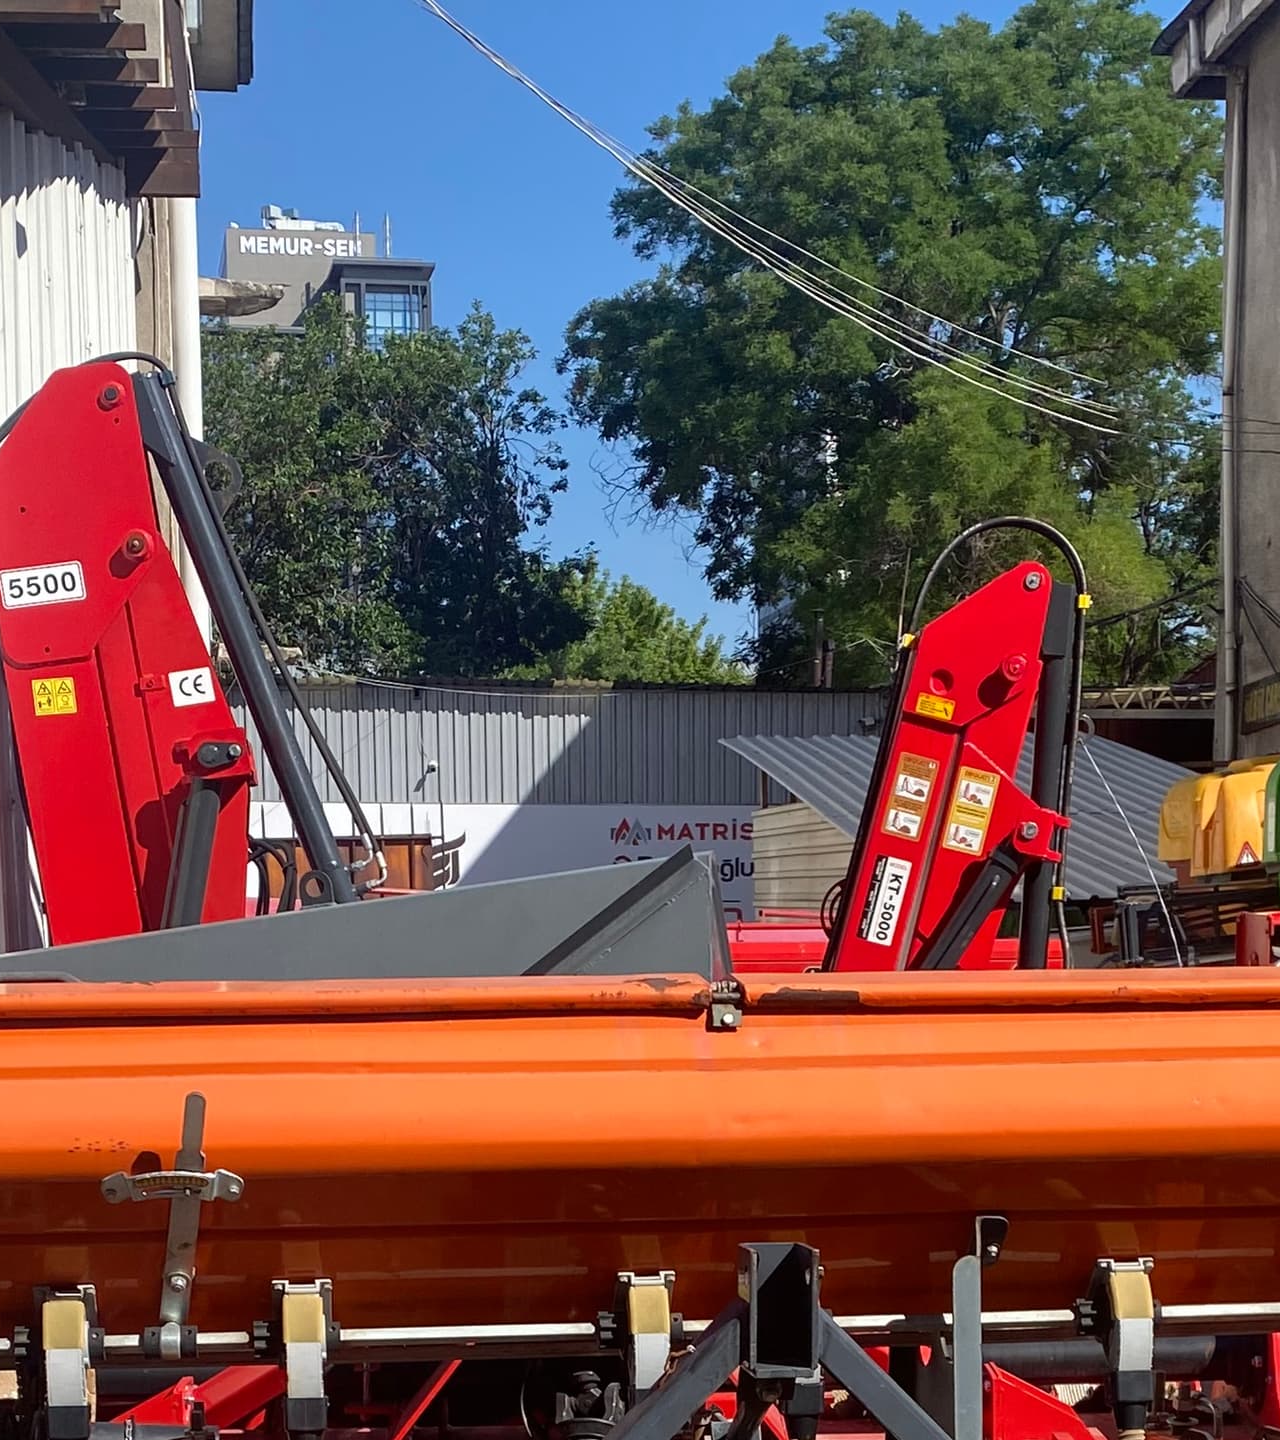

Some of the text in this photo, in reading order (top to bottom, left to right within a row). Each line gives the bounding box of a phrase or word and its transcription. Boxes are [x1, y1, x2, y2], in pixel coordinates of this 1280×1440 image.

[240, 235, 362, 257] MEMUR-SEN
[8, 571, 77, 599] 5500
[178, 674, 206, 696] CE
[875, 872, 904, 941] KT-5000
